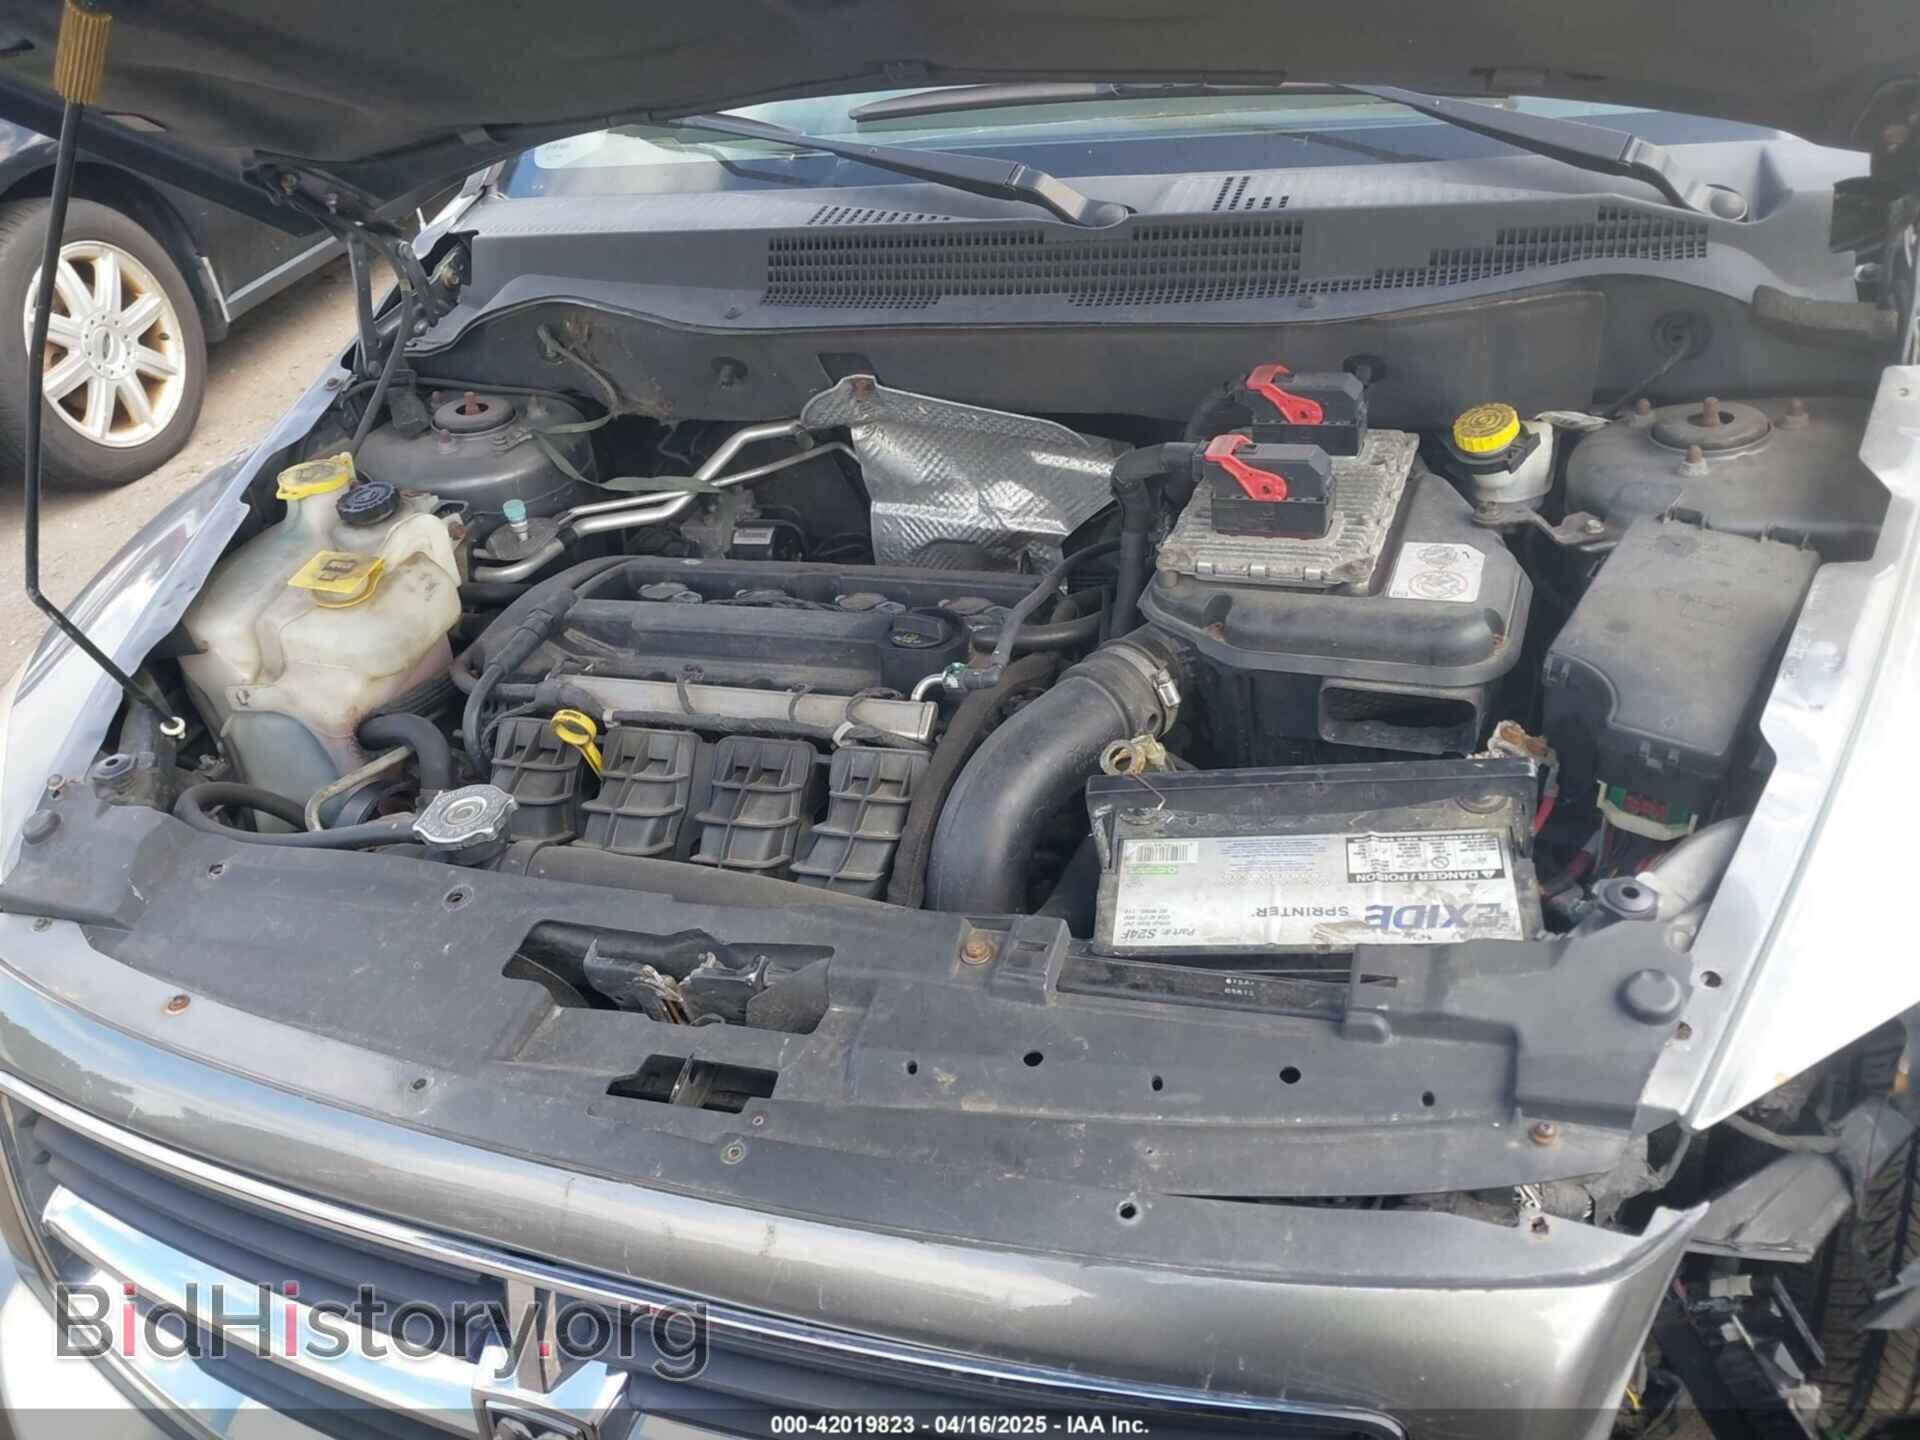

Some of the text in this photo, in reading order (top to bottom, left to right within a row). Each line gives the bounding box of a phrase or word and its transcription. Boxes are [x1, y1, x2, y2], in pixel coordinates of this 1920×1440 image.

[1356, 872, 1409, 882] POISON
[1418, 871, 1479, 880] DANGER
[1256, 906, 1349, 917] SPRINTER
[1364, 903, 1502, 929] EXIDE
[1120, 928, 1157, 939] S24F
[1172, 928, 1196, 936] Part
